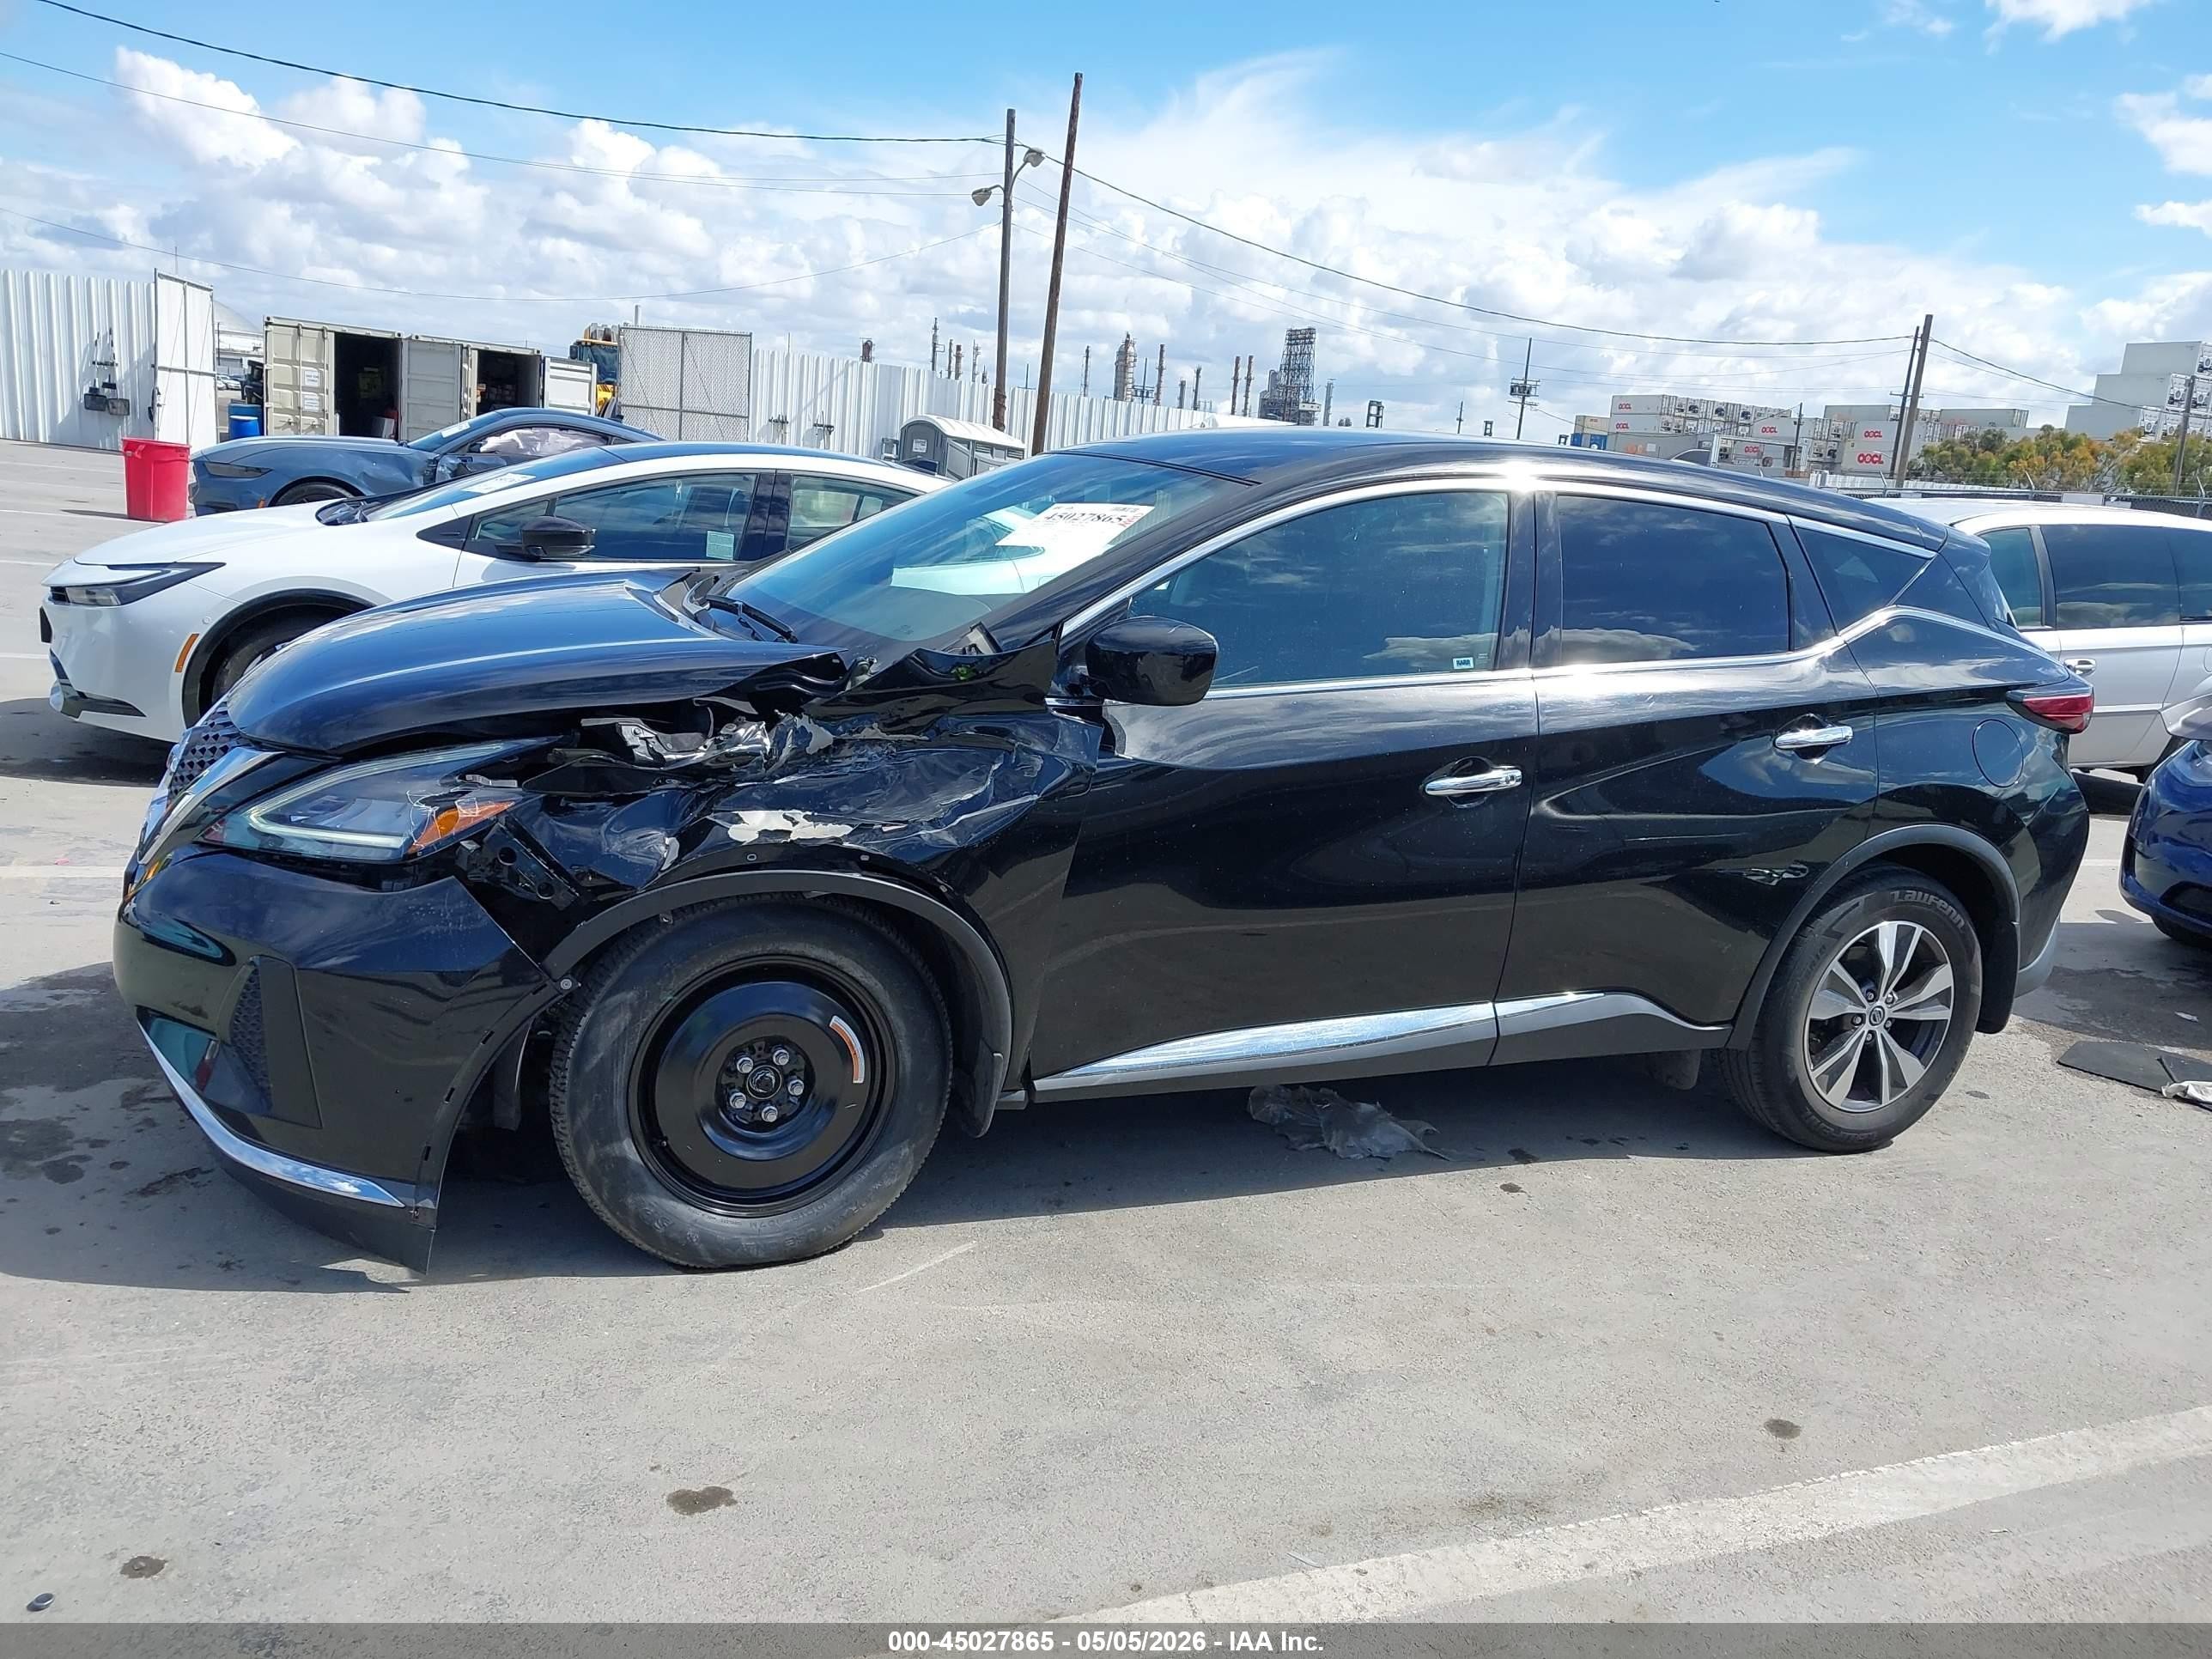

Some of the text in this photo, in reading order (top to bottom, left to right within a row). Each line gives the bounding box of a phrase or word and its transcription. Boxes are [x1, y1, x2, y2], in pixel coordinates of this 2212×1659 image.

[1863, 430, 1882, 439] OOCL
[1857, 453, 1884, 465] OOCL
[1044, 513, 1127, 523] 45027865
